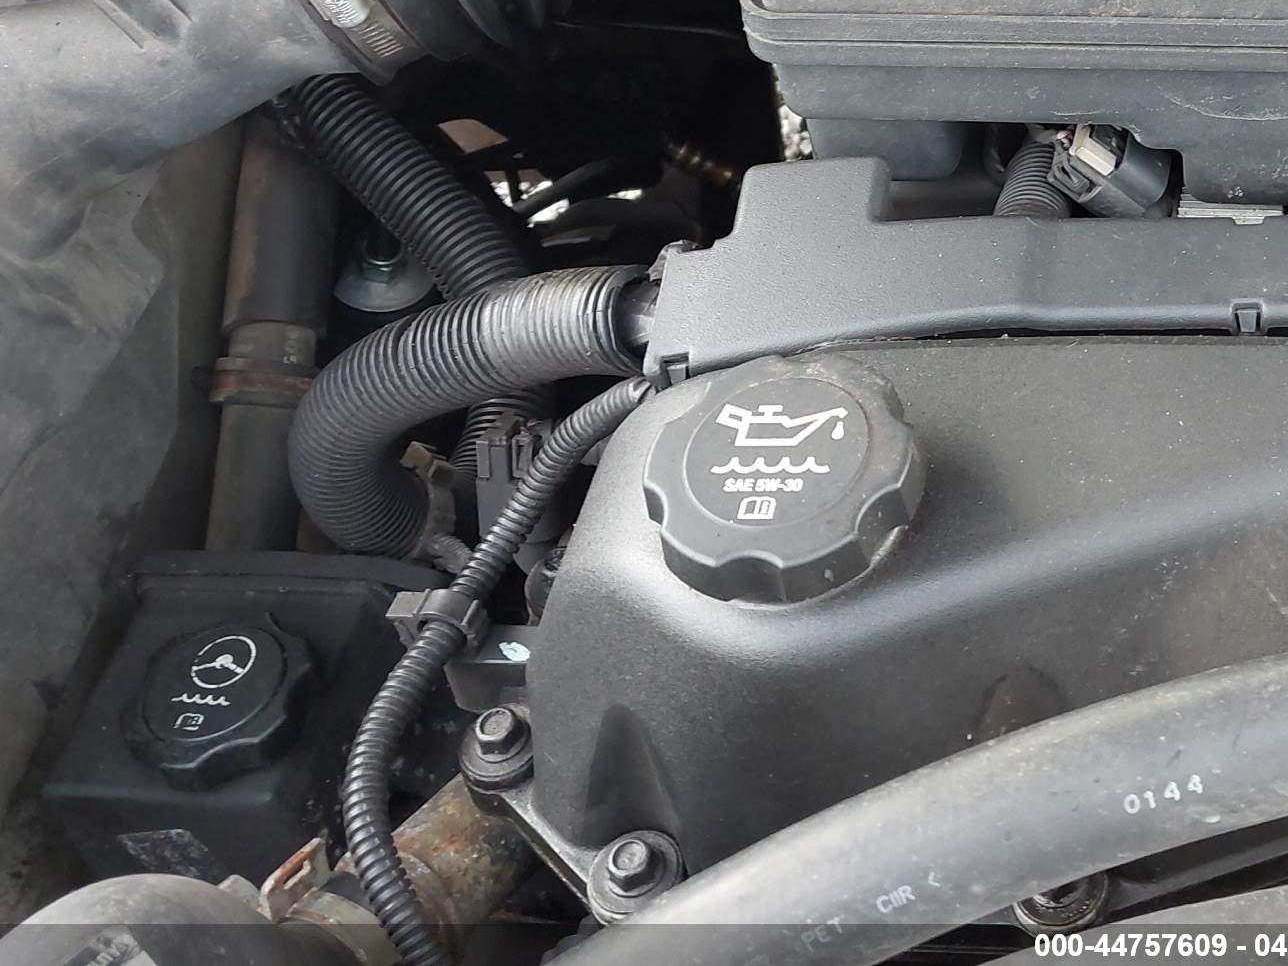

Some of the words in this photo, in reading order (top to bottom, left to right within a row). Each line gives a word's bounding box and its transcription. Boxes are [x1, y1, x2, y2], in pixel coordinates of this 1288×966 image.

[723, 477, 755, 492] SAE
[755, 477, 804, 492] 5W-30
[1123, 774, 1203, 814] 0144
